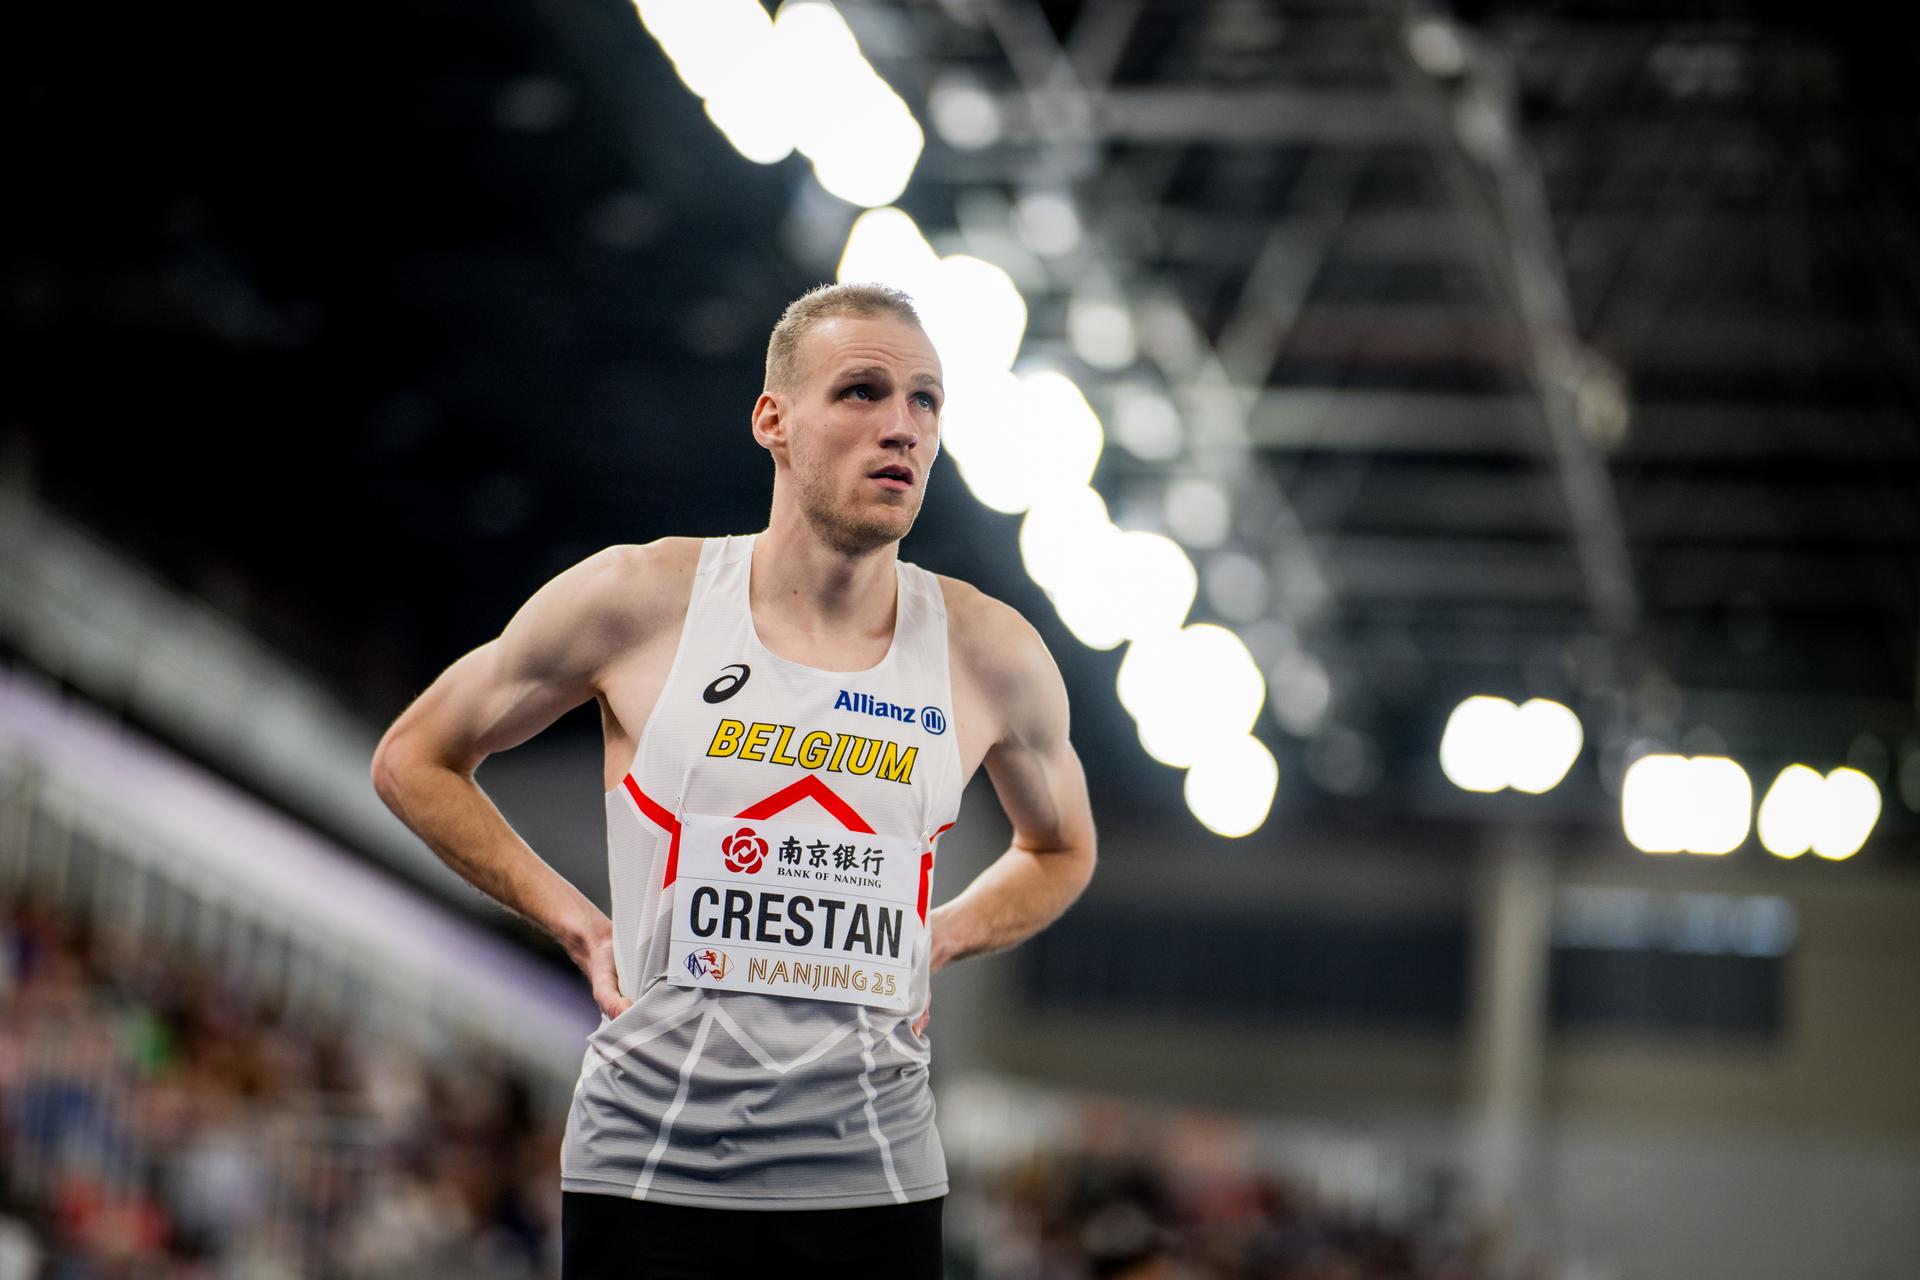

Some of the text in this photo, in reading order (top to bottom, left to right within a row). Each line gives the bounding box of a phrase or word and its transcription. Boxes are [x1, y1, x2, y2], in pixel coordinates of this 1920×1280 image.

[834, 690, 916, 723] Allianz
[706, 718, 918, 785] BELGIUM
[778, 835, 884, 876] 南京银行
[777, 867, 882, 888] BANK OF NANJING
[690, 886, 903, 959] CRESTAN
[748, 957, 896, 995] NANJING 25
